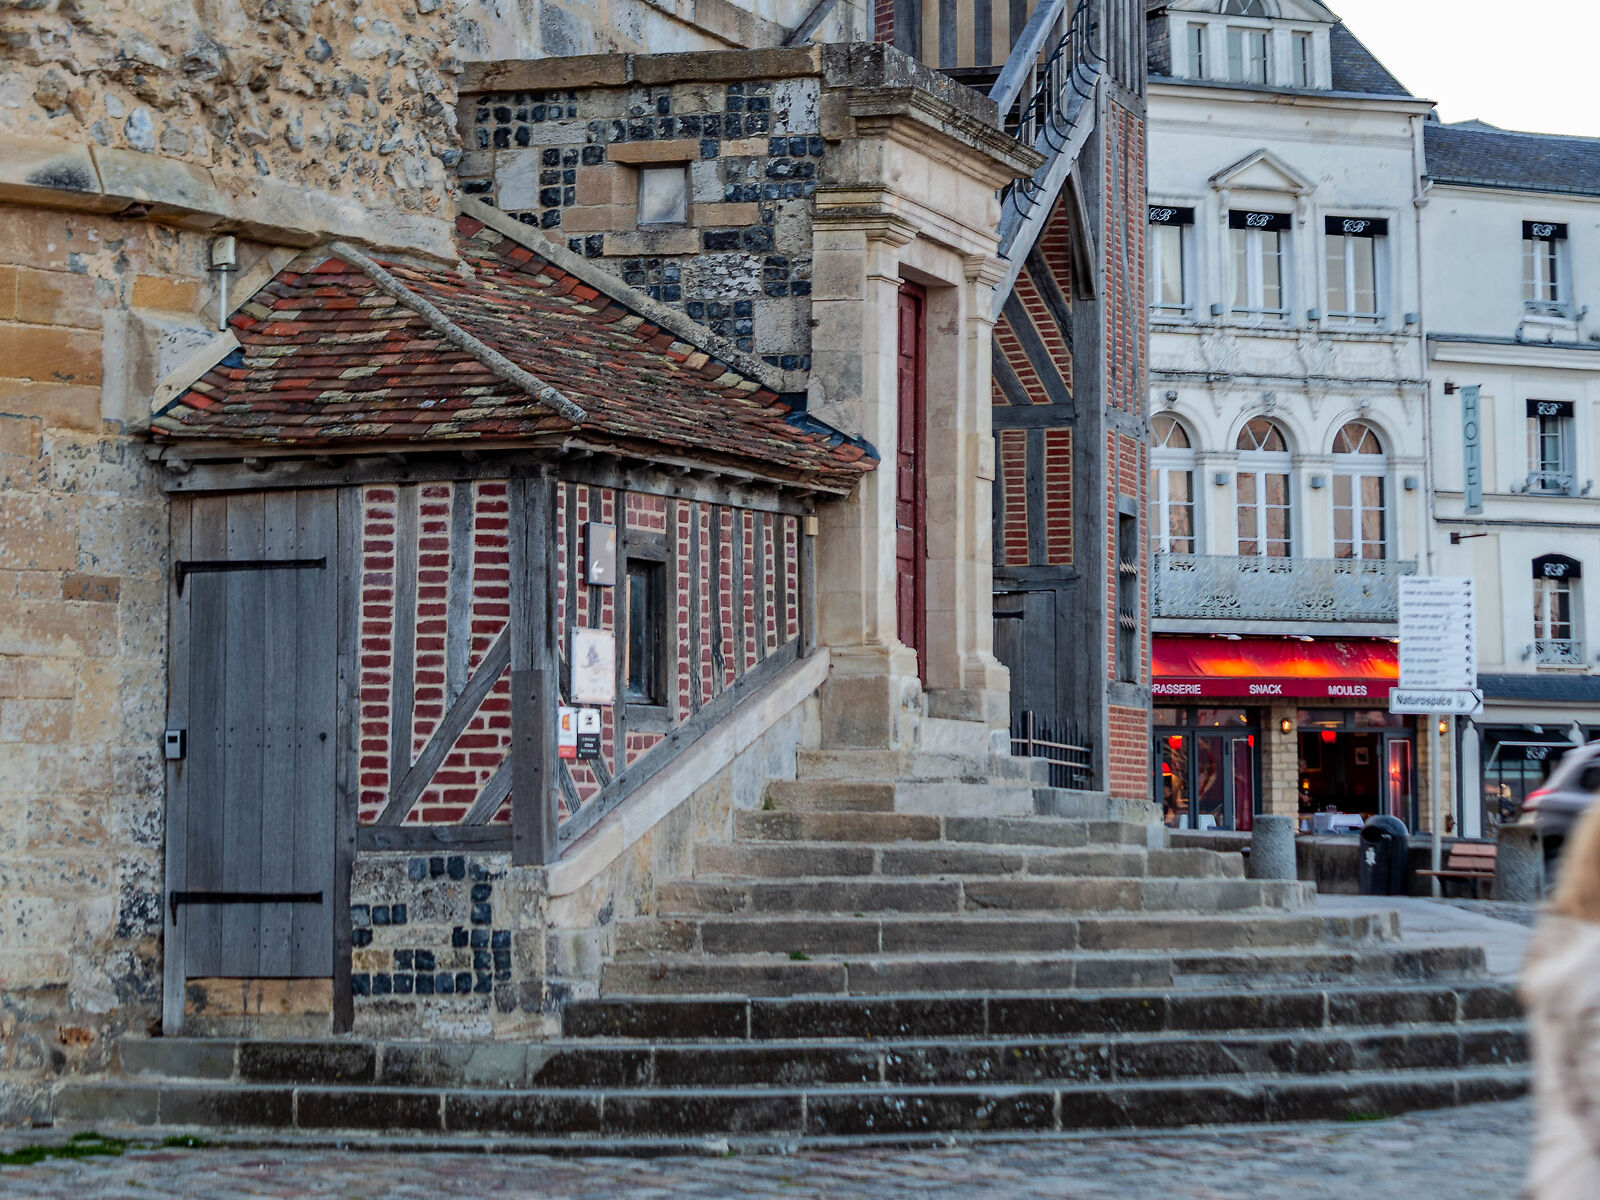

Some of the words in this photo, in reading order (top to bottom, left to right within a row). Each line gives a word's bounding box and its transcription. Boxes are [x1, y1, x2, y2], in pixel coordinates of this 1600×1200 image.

[1464, 399, 1479, 508] HOTEL
[1249, 684, 1282, 694] SNACK
[1328, 685, 1367, 696] MOULES
